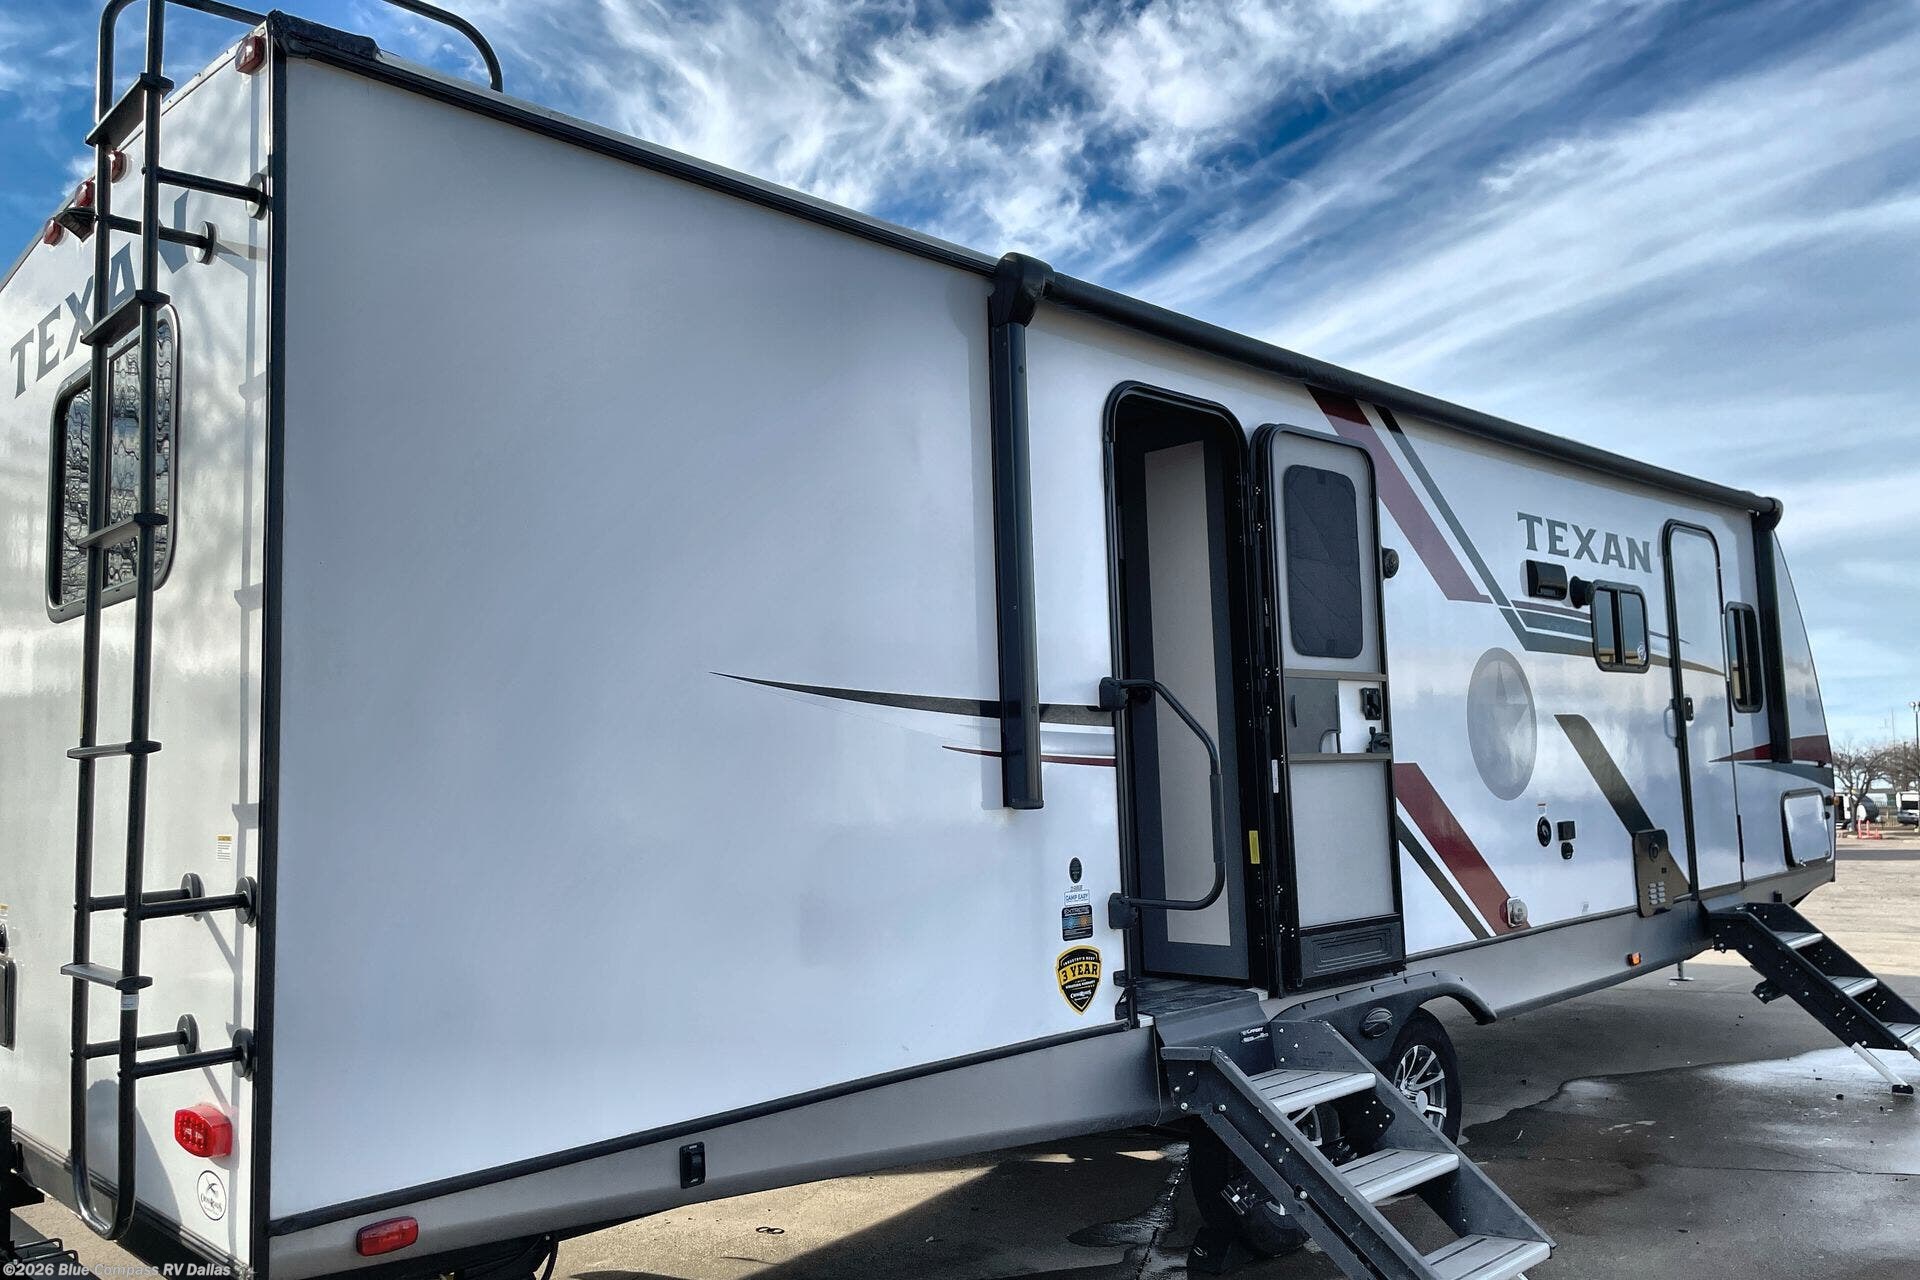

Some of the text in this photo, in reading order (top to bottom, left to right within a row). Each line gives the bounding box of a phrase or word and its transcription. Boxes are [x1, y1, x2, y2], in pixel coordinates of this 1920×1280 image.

[1517, 511, 1652, 573] TEXAN
[1061, 963, 1098, 982] 3 YEAR
